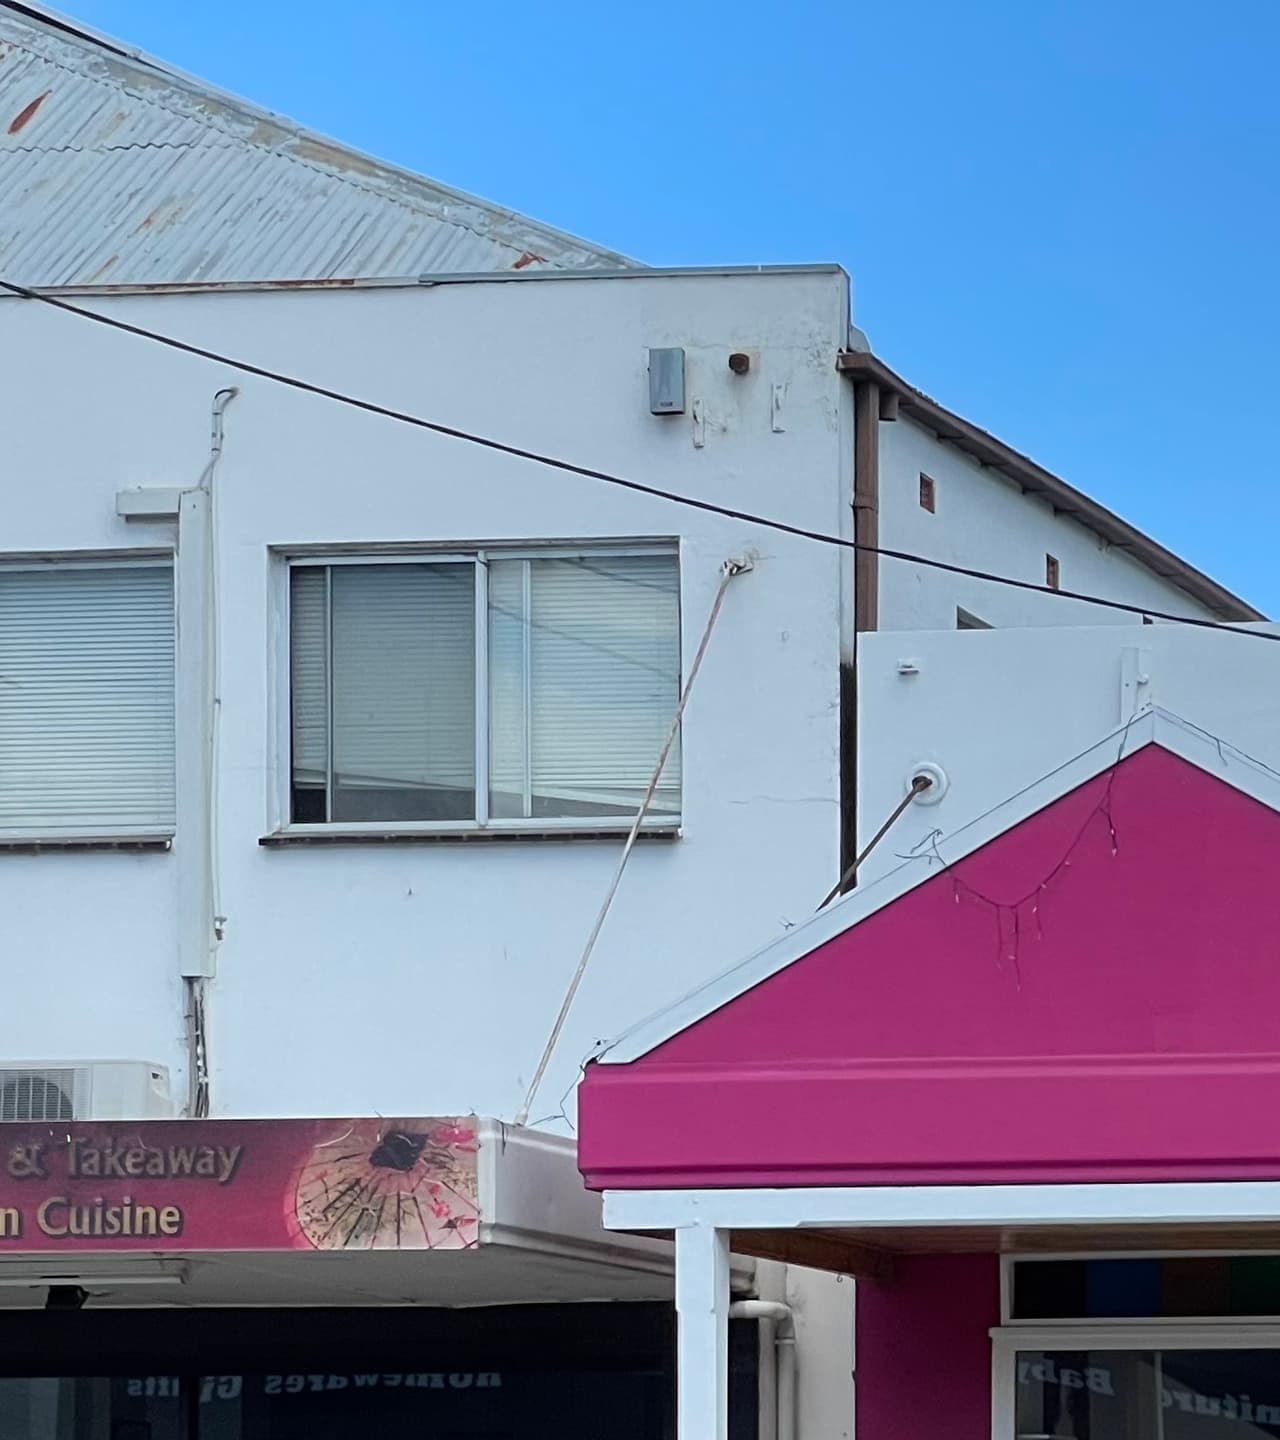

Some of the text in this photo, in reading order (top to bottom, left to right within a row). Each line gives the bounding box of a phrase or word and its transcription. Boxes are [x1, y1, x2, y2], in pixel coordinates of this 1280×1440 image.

[8, 1136, 240, 1183] & Takeaway
[36, 1195, 182, 1236] Cuisine
